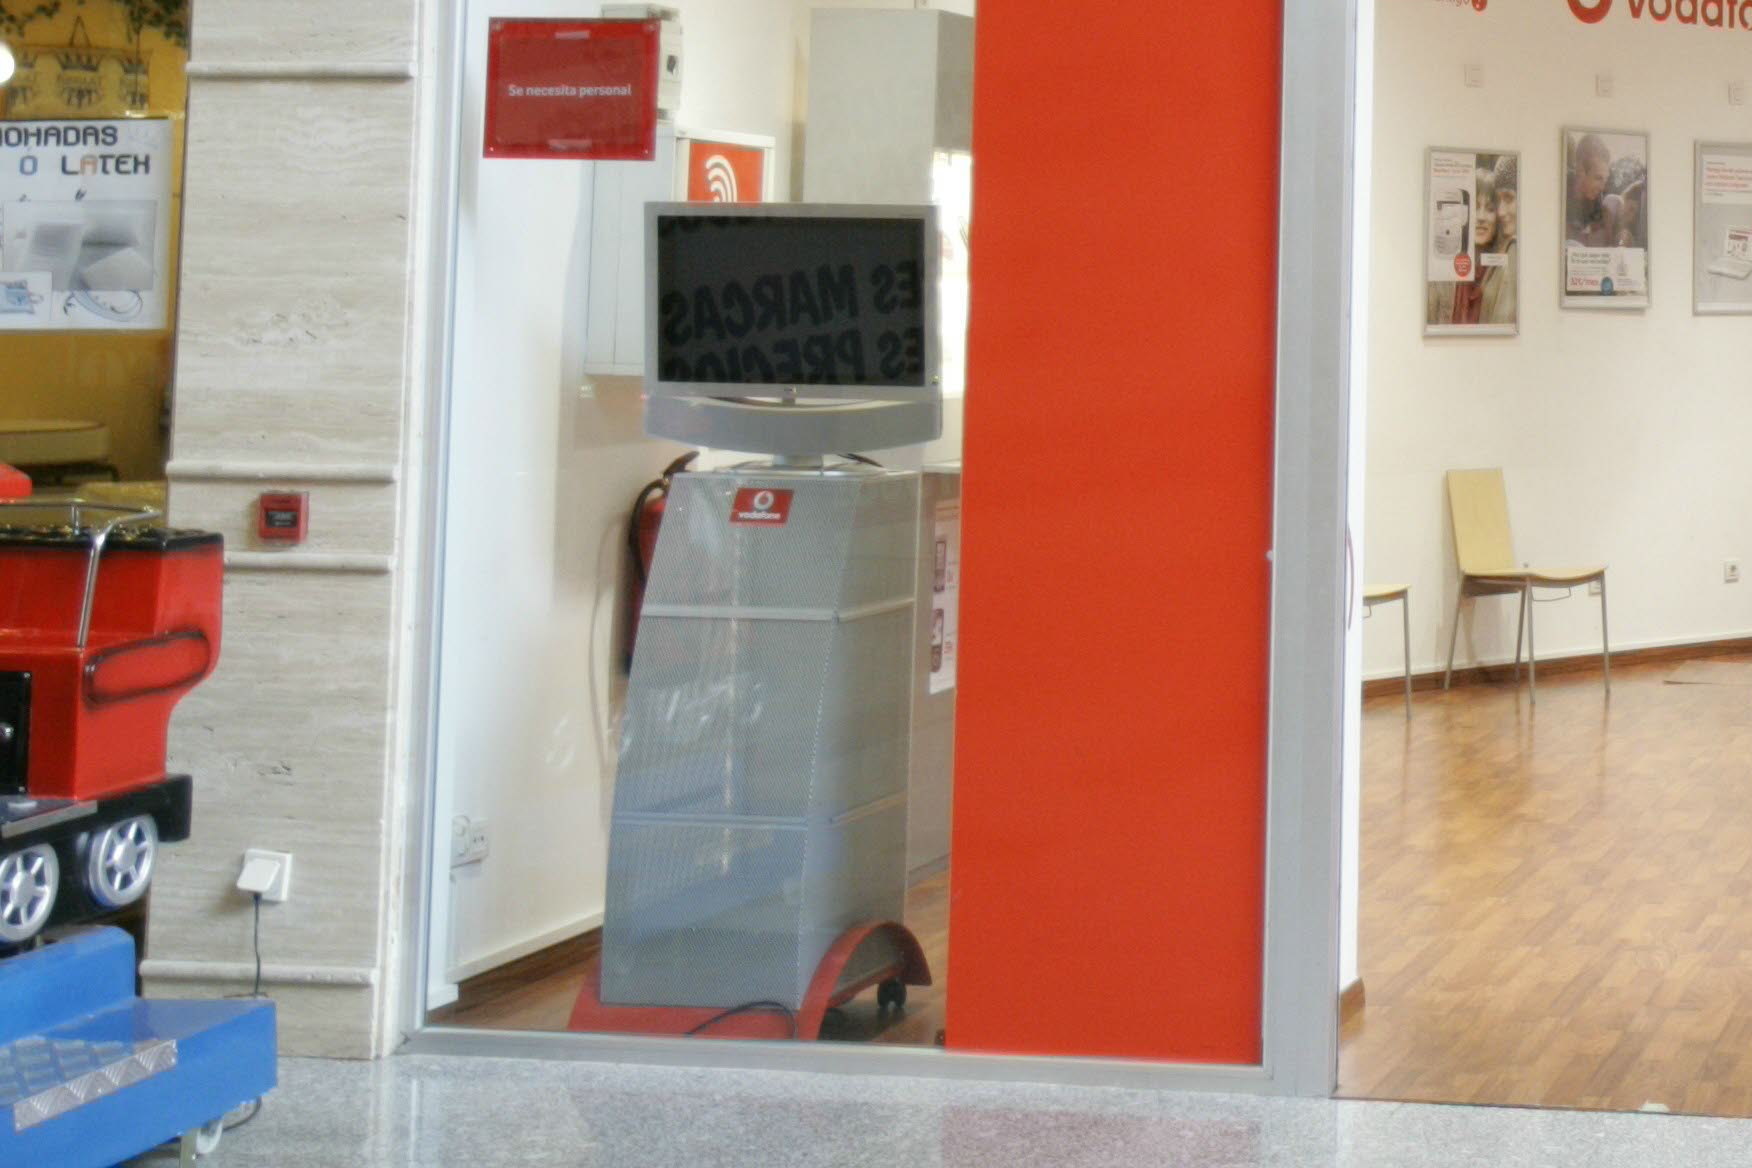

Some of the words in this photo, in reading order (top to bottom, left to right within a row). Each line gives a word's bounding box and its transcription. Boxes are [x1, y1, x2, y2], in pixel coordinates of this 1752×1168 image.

[508, 83, 524, 97] Se
[526, 84, 577, 97] necesita
[579, 83, 632, 99] personal
[0, 126, 119, 147] OHADAS
